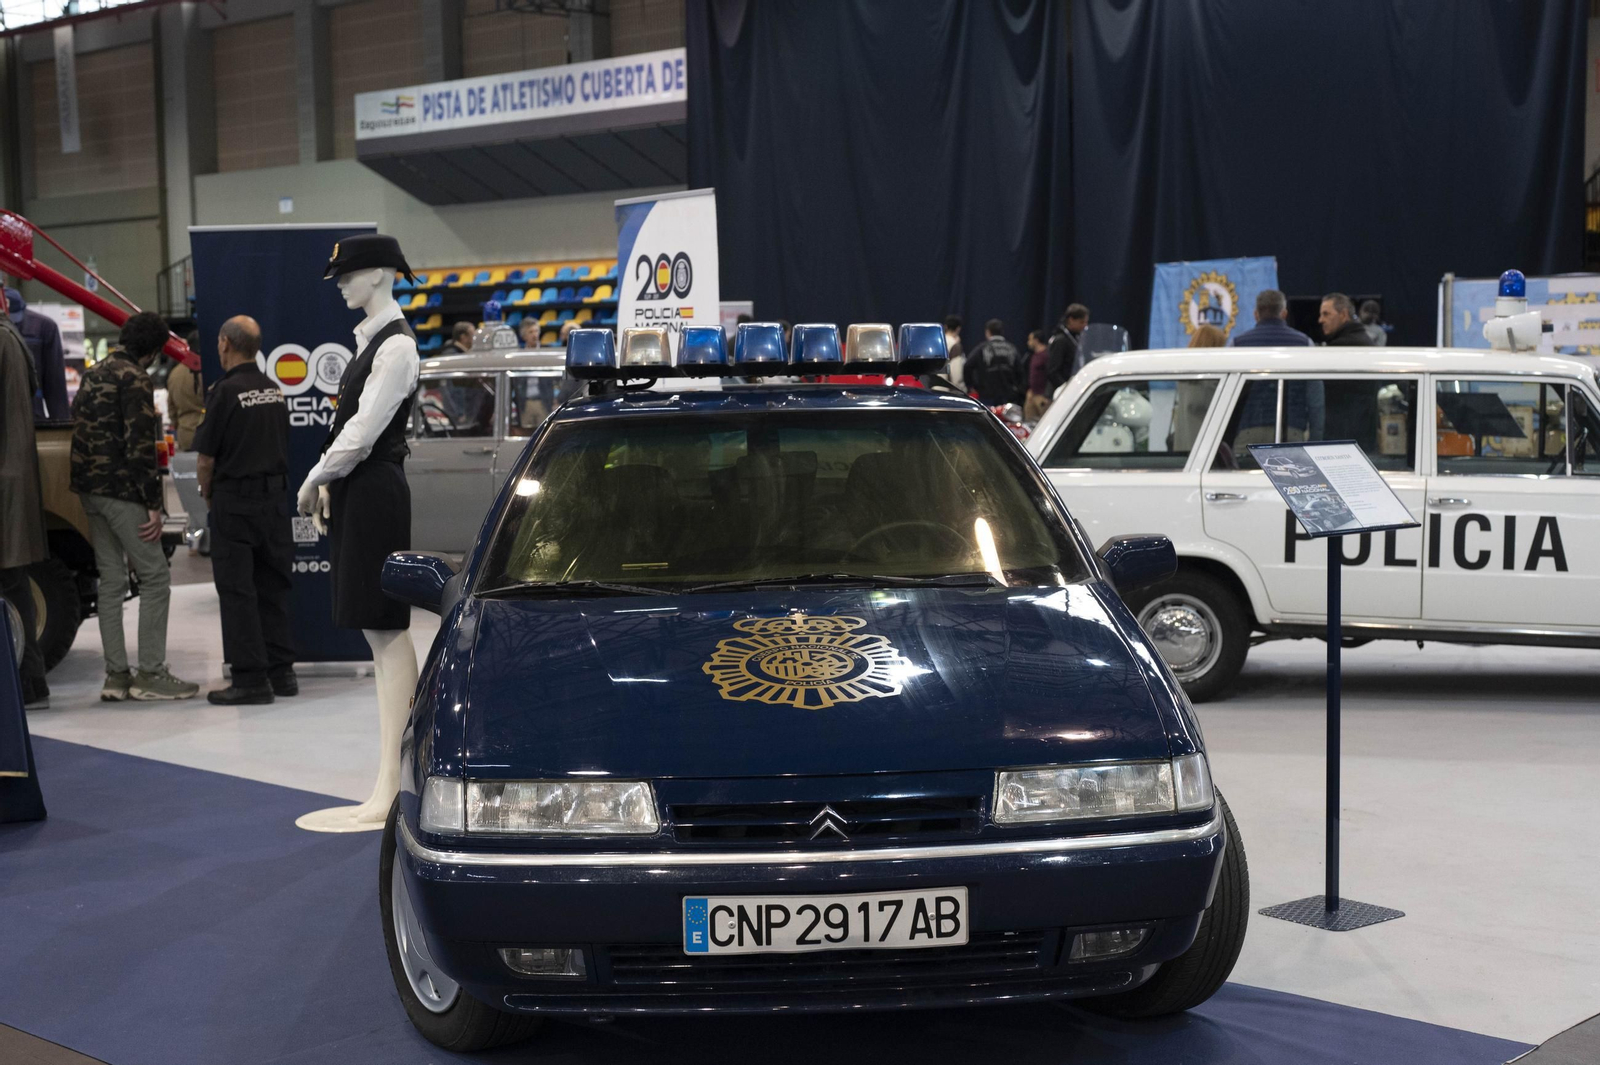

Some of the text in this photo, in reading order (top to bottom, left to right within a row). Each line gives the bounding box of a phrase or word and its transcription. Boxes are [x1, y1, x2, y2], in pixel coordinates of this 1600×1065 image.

[422, 58, 684, 122] PISTA DE ATLETISMO CUBERTA DE
[635, 251, 693, 301] 200
[635, 307, 682, 319] POLICIA
[241, 396, 285, 409] NACION
[751, 644, 862, 661] CUERPO NACIONAL DE
[692, 932, 702, 944] E
